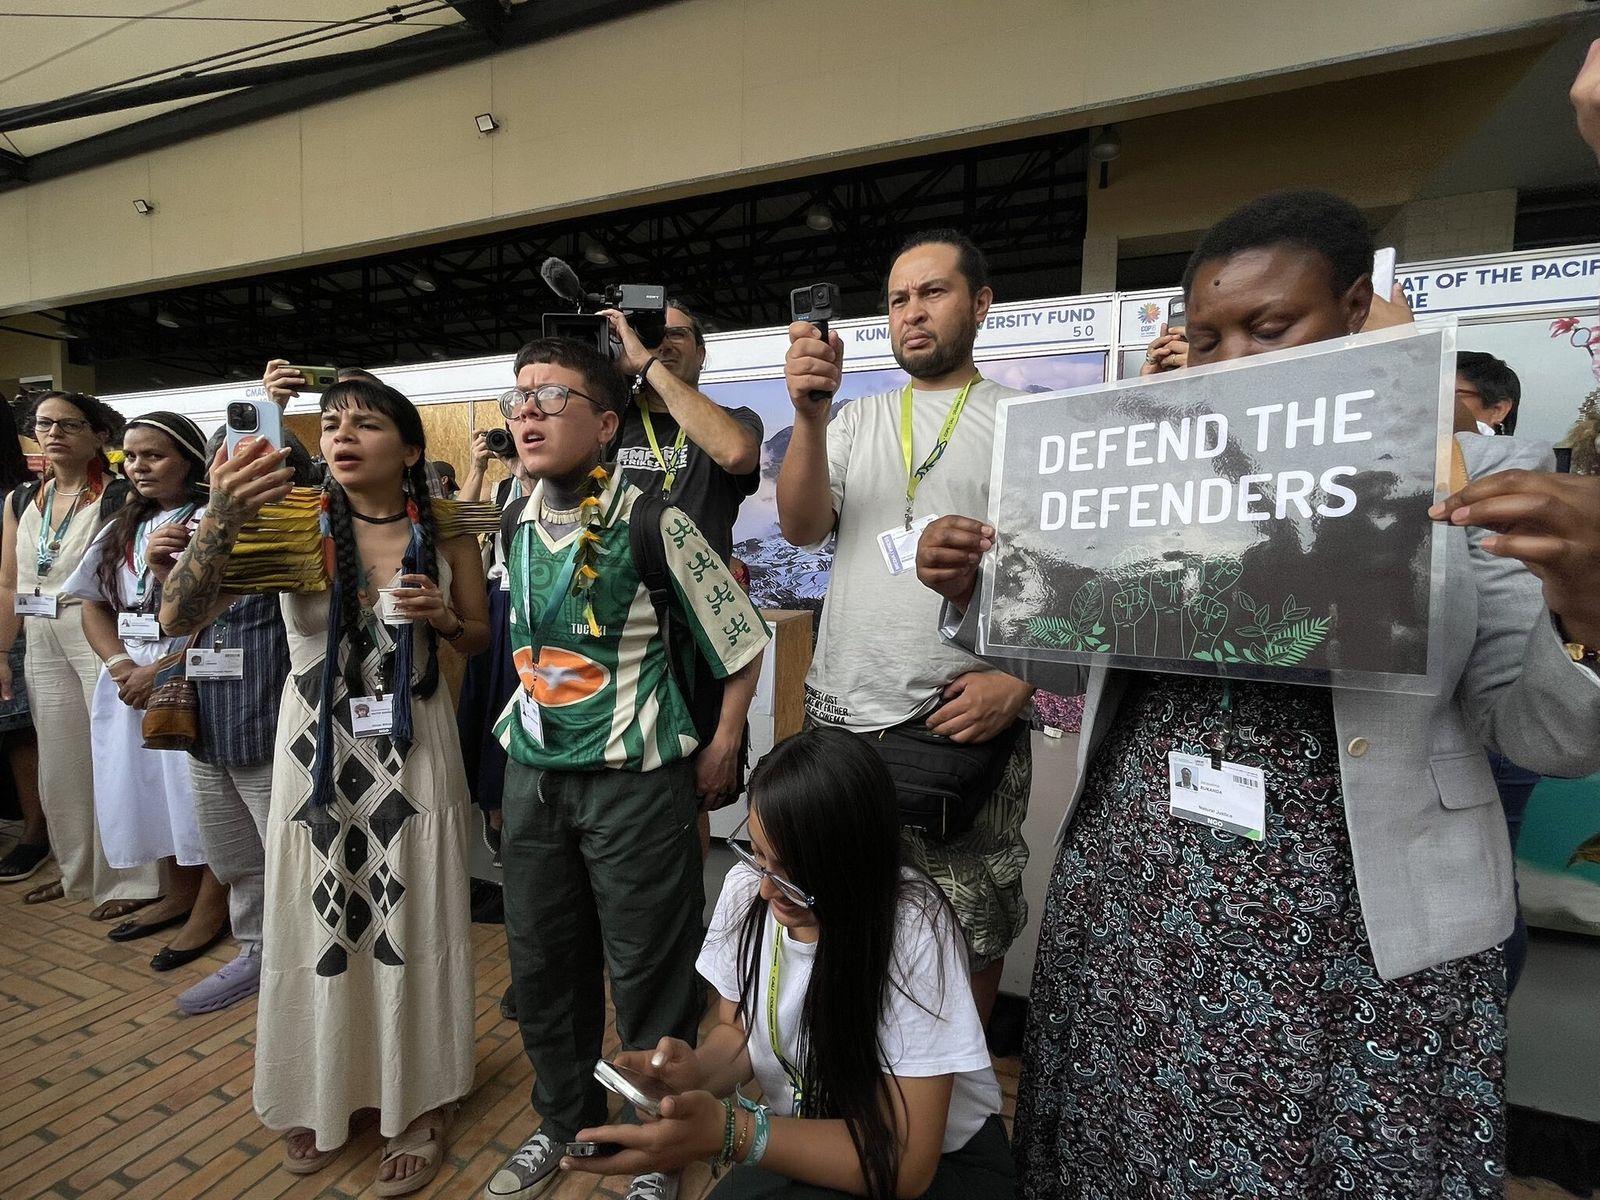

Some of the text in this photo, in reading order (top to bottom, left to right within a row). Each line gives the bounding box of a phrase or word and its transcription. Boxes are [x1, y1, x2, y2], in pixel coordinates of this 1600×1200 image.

[1394, 258, 1600, 292] AT OF THE PACIF
[986, 308, 1096, 330] ERSITY FUND
[856, 327, 890, 341] KUN
[1038, 389, 1375, 475] DEFEND THE
[1039, 465, 1357, 531] DEFENDERS
[1207, 817, 1224, 827] NGO
